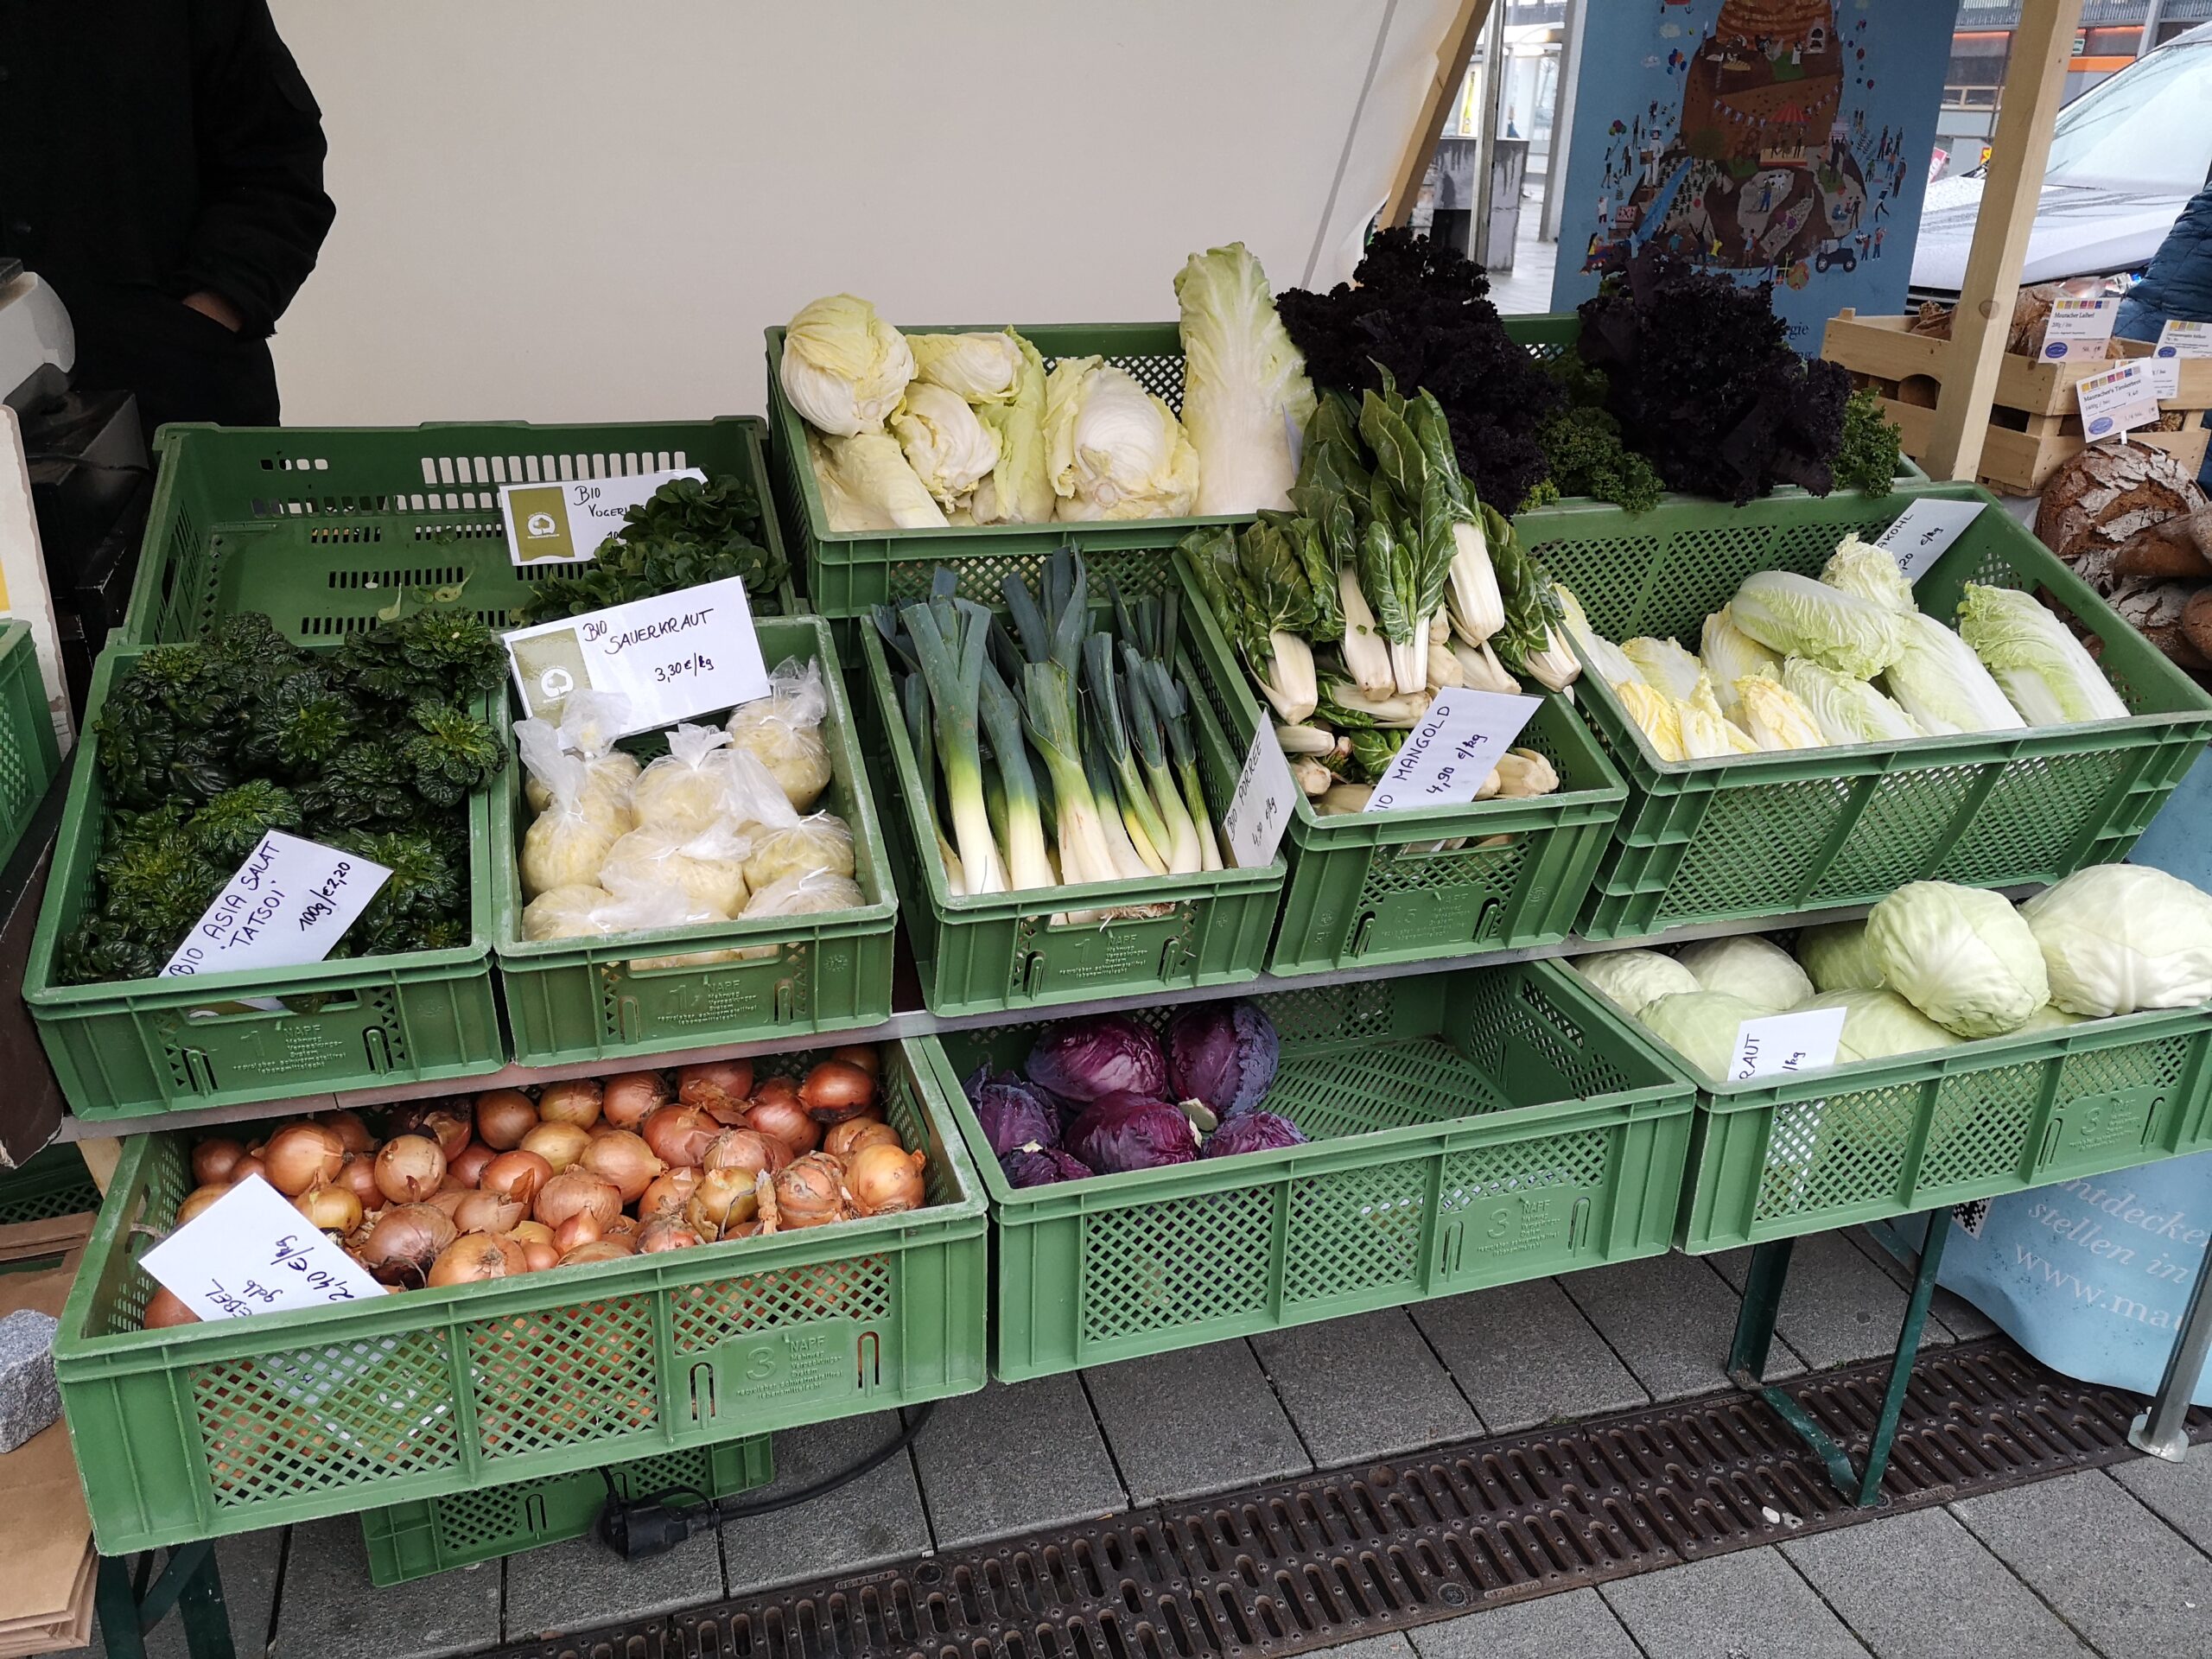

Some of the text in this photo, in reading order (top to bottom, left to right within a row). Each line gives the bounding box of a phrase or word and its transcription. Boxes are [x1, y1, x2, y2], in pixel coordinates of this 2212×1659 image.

[574, 486, 601, 505] BIO
[582, 620, 607, 642] BIO
[604, 608, 715, 655] SAUERKRAUT
[1368, 705, 1450, 812] IO MANGOLD
[1227, 731, 1262, 842] BIO PORREE
[168, 840, 280, 976] BIO ASIA SALAT
[1487, 1208, 1511, 1239] 3
[2059, 1178, 2210, 1248] ntdecke
[2028, 1202, 2189, 1285] stellen in
[242, 1280, 283, 1303] gelb
[307, 1271, 354, 1301] 2,40
[790, 1336, 825, 1352] NAPF
[747, 1346, 777, 1382] 3
